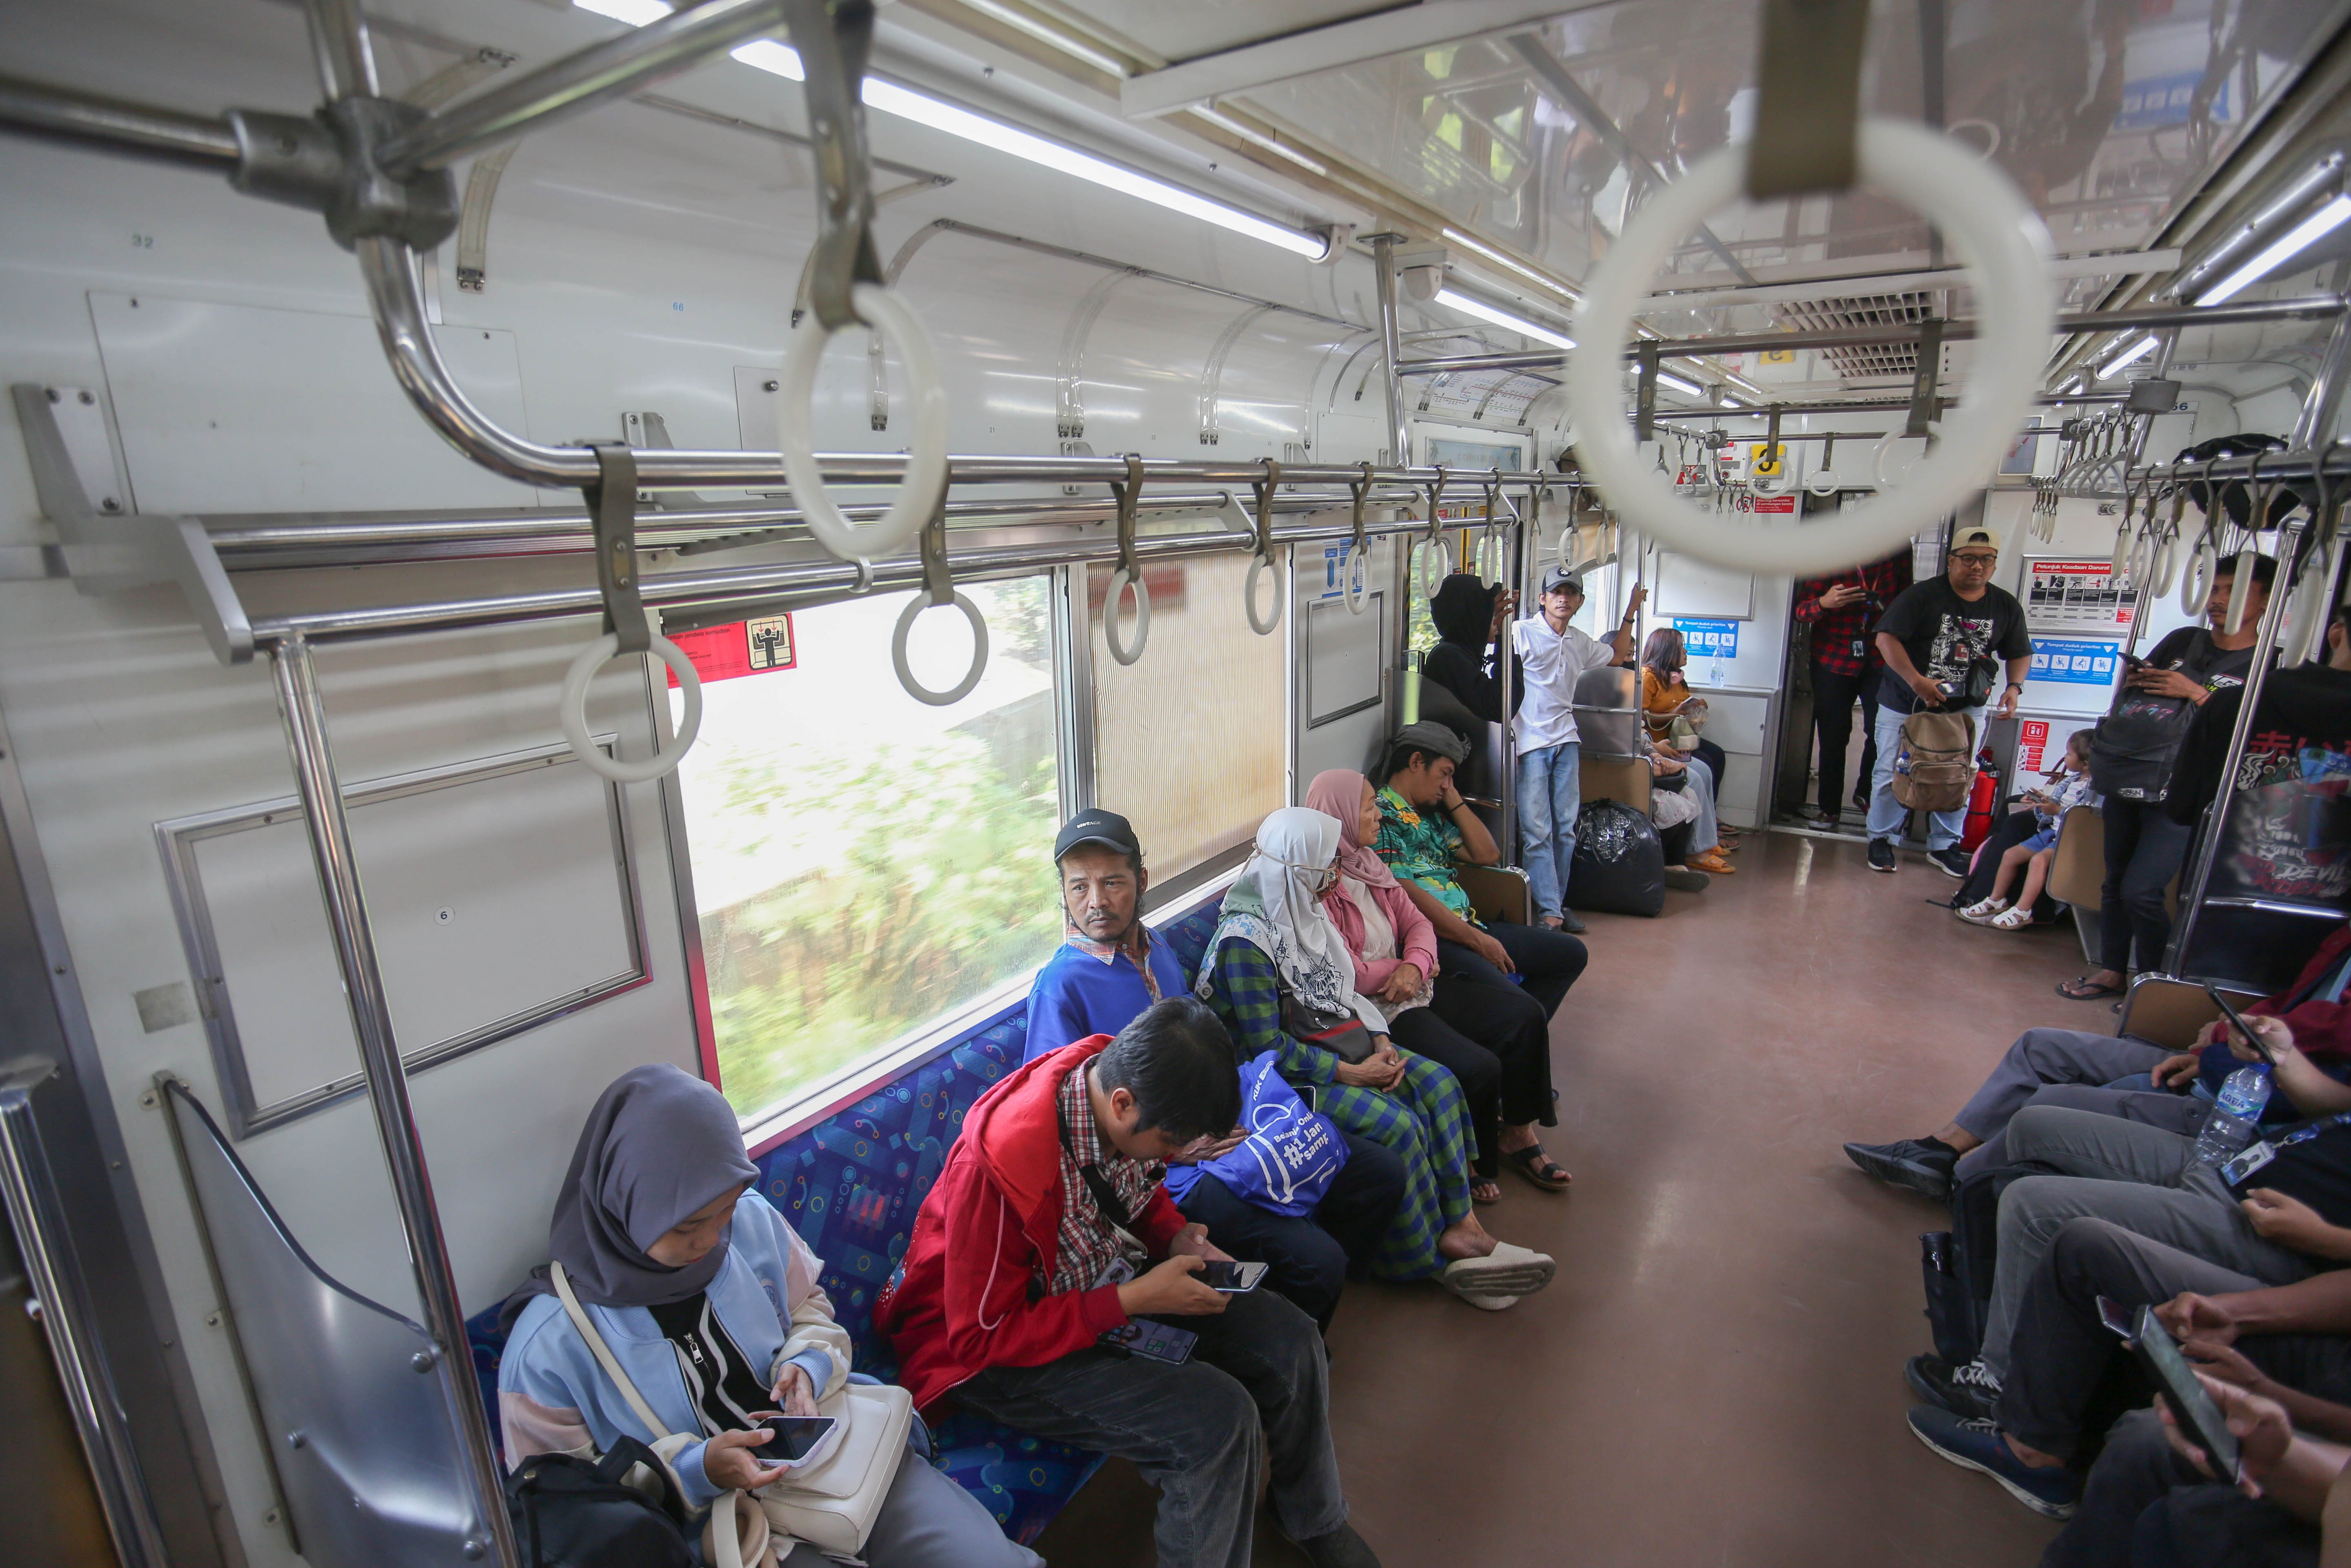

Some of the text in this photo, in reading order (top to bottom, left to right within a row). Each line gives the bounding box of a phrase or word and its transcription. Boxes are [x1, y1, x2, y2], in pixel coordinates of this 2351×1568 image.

[673, 302, 684, 311] 66
[441, 911, 447, 919] 6
[2220, 1091, 2244, 1108] AQUA
